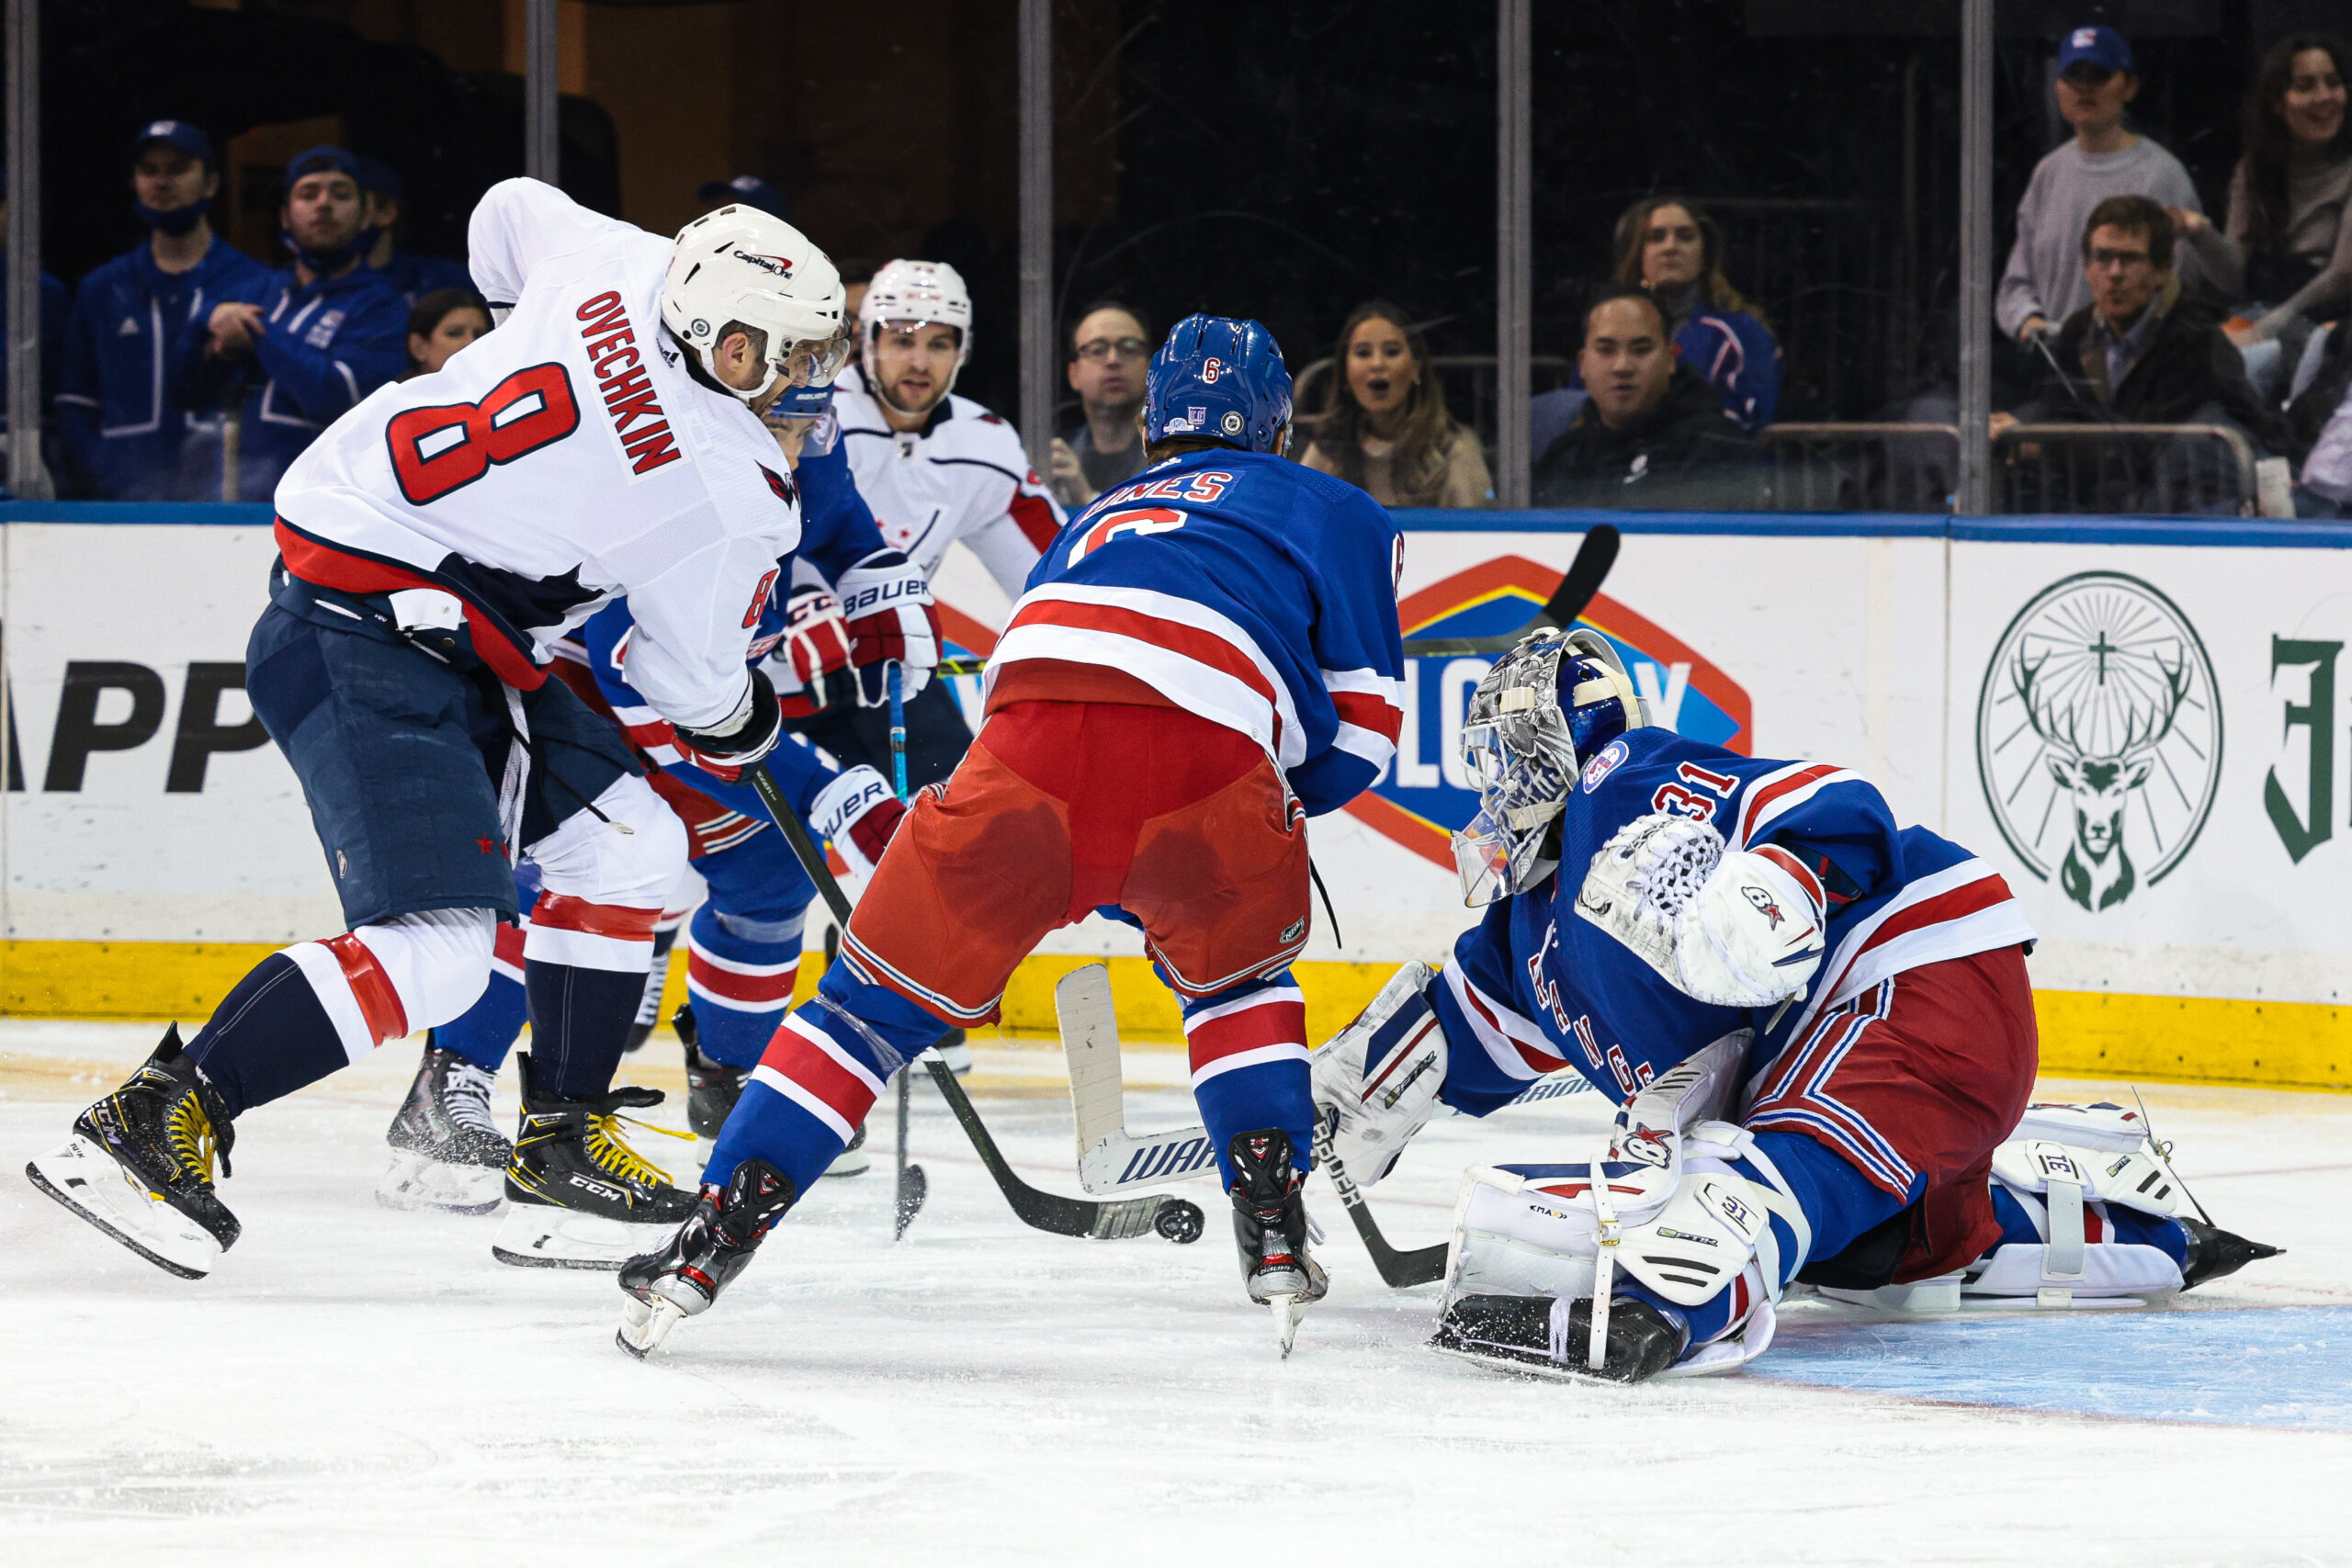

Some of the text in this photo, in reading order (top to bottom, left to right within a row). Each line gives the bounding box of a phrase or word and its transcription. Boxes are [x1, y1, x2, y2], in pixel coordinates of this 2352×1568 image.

[576, 290, 682, 476] OVECHKIN
[1203, 357, 1221, 384] 6
[385, 361, 581, 506] 8
[741, 569, 779, 629] 8
[787, 594, 838, 628] CC
[2265, 634, 2352, 865] J
[1650, 760, 1741, 822] 31
[569, 1176, 622, 1201] CCM
[1313, 1120, 1364, 1210] BAUER
[2046, 1155, 2073, 1173] 31
[1722, 1194, 1748, 1224] 31
